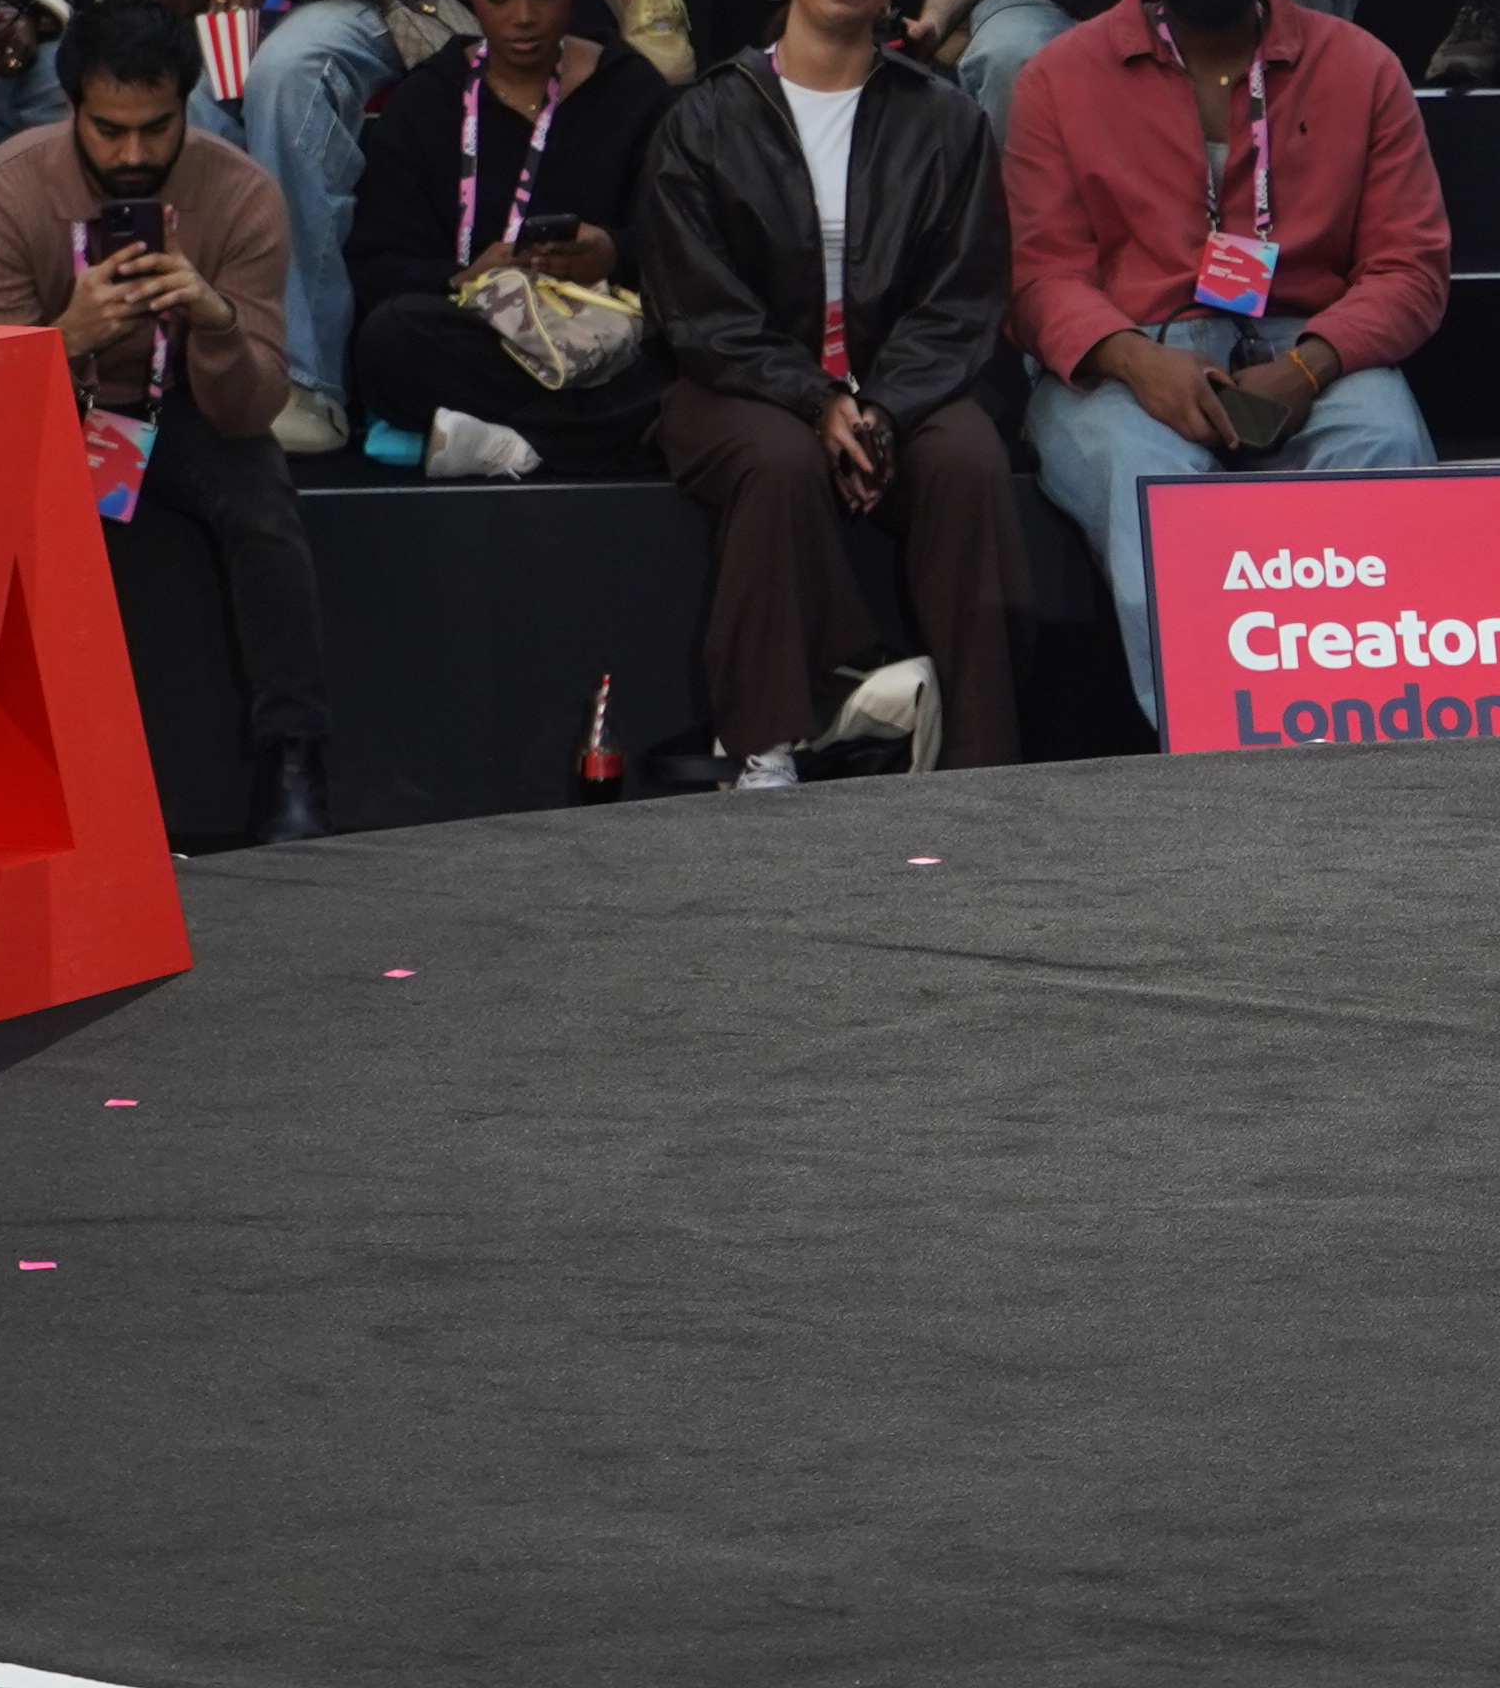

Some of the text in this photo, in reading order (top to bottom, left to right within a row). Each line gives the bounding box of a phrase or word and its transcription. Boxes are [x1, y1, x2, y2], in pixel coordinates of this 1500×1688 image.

[1251, 60, 1264, 99] Adobe
[1257, 168, 1268, 209] Adobe
[1223, 547, 1386, 590] Adobe
